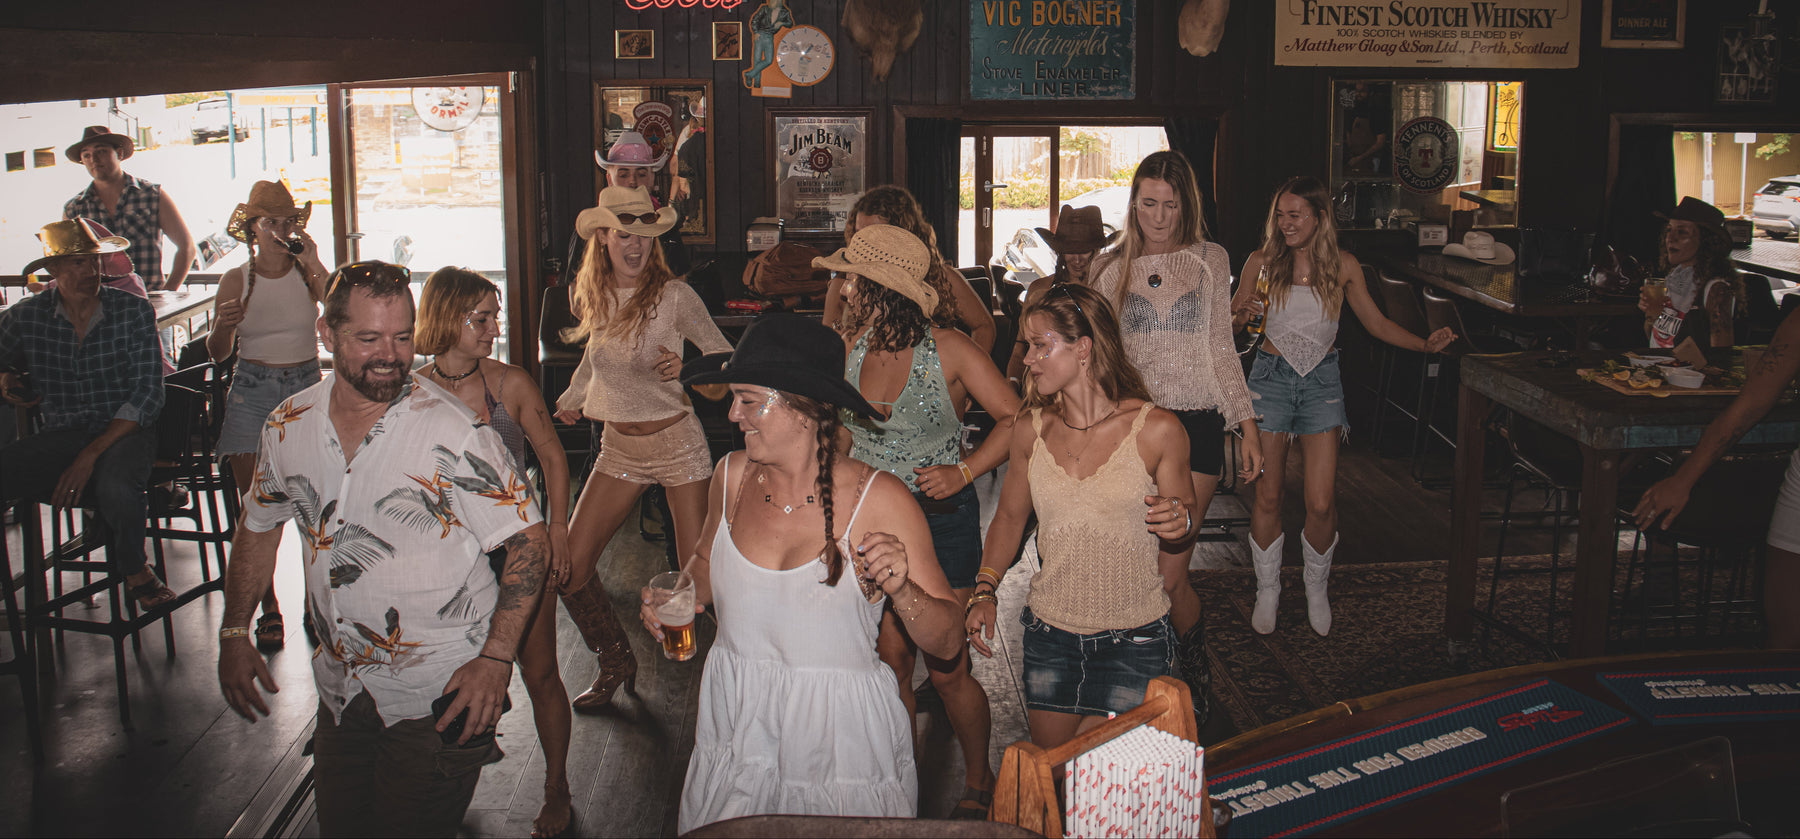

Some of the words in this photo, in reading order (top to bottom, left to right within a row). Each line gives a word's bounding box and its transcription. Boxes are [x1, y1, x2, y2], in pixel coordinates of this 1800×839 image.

[983, 1, 1021, 26] VIC
[1032, 0, 1121, 26] BOGNER
[1300, 0, 1383, 26] FINEST
[1388, 0, 1468, 27] SCOTCH
[1470, 2, 1557, 28] WHISKY
[1618, 17, 1650, 28] DINNER
[1653, 17, 1668, 28] ALE
[1336, 29, 1359, 38] 100%
[1363, 29, 1405, 38] SCOTCH
[1409, 29, 1457, 39] WHISKIES
[1461, 30, 1507, 39] BLENDED
[1510, 31, 1524, 40] BY
[997, 27, 1109, 68] Motorcycles
[1284, 38, 1357, 52] Matthew
[1358, 39, 1396, 56] Gloag
[1469, 40, 1510, 55] Perth,
[1513, 41, 1570, 55] Scotland
[1020, 82, 1087, 97] LINER
[789, 133, 813, 155] JIM
[816, 128, 852, 155] BEAM
[1401, 122, 1450, 144] TENNENT'S
[1418, 148, 1433, 168] T
[1396, 726, 1487, 761] BREWED
[1353, 752, 1404, 776] FOR
[1308, 766, 1361, 790] THE
[1228, 781, 1316, 820] THIRST
